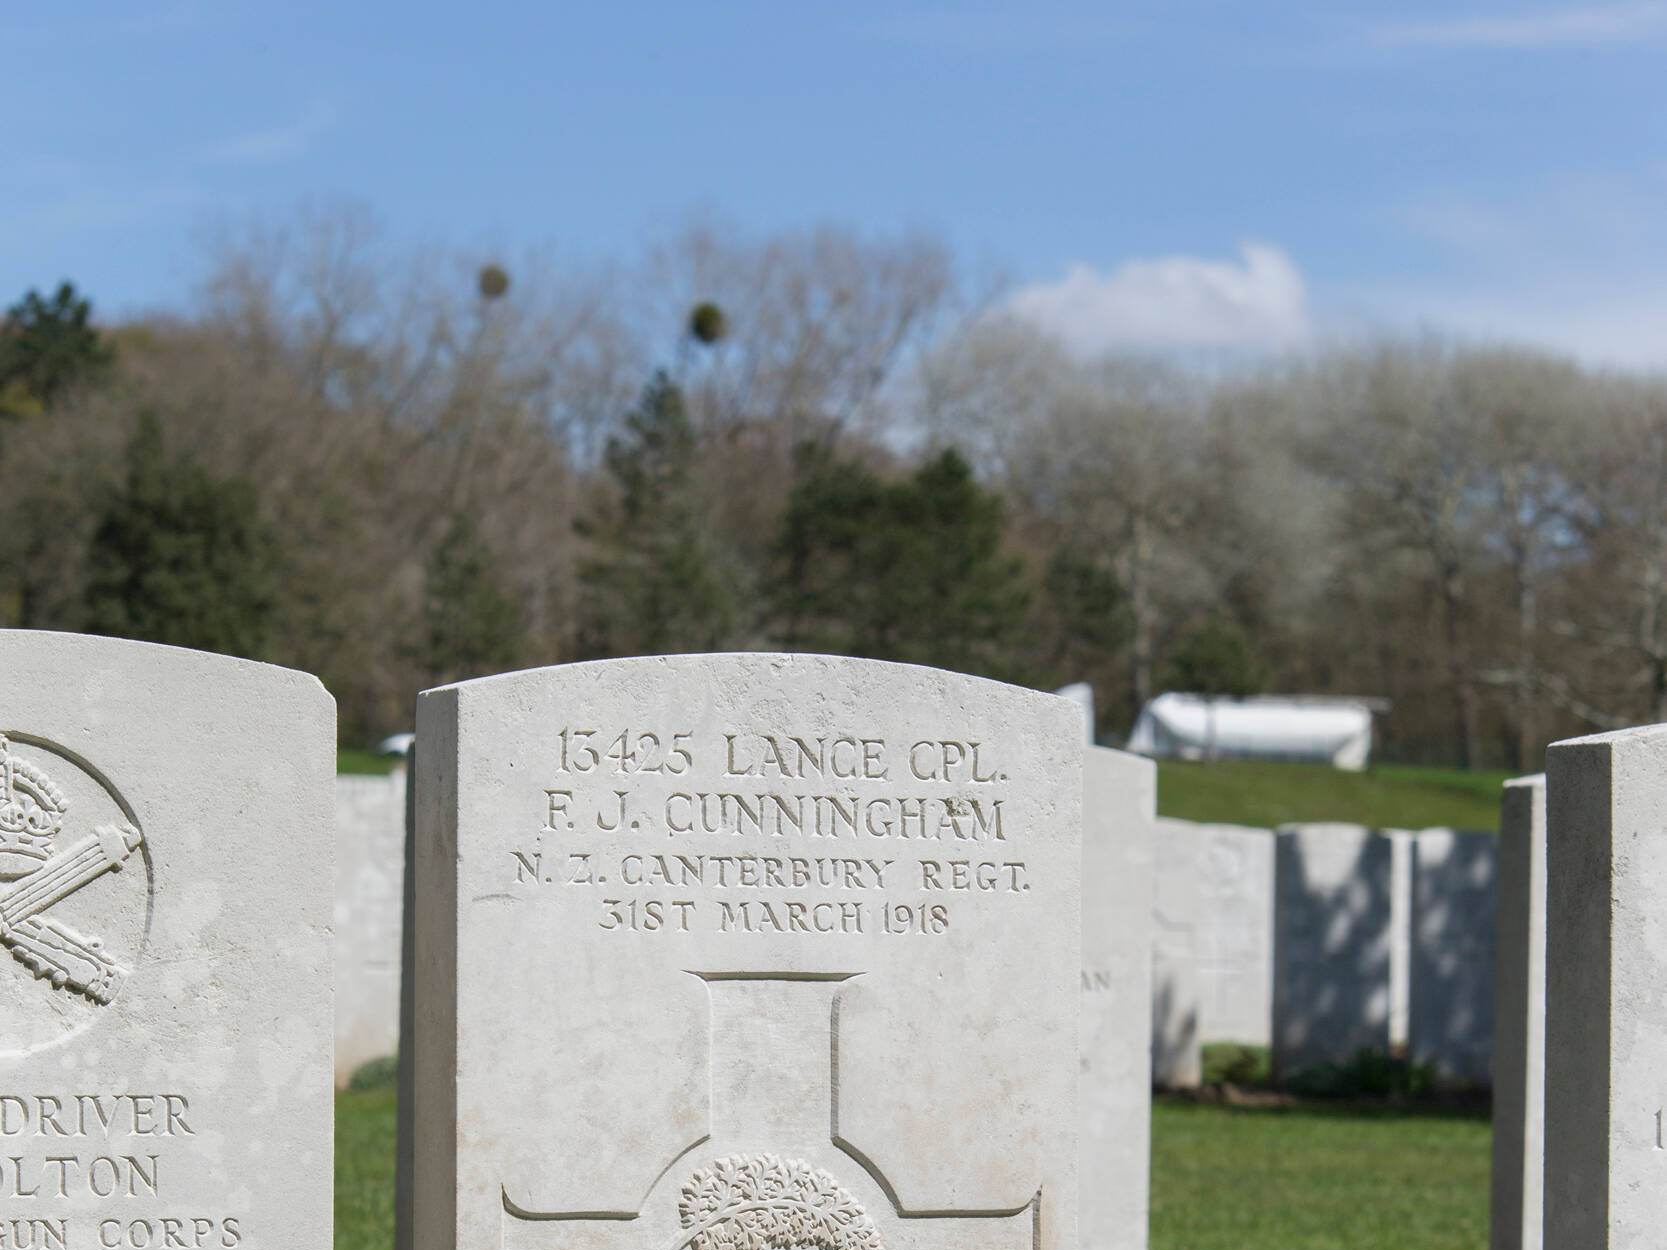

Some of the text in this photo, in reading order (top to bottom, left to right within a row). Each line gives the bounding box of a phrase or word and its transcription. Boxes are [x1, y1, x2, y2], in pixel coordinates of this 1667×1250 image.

[557, 727, 1009, 783] 13425 LANCE CPL.
[543, 789, 1006, 842] F. J. CUNNINGHAM
[510, 851, 1030, 893] N. Z. CANTERBURY REGT.
[598, 899, 949, 936] 31ST MARCH 1918
[0, 1094, 195, 1136] DRIVER
[0, 1154, 160, 1198] LTON
[99, 1217, 242, 1249] CORPS
